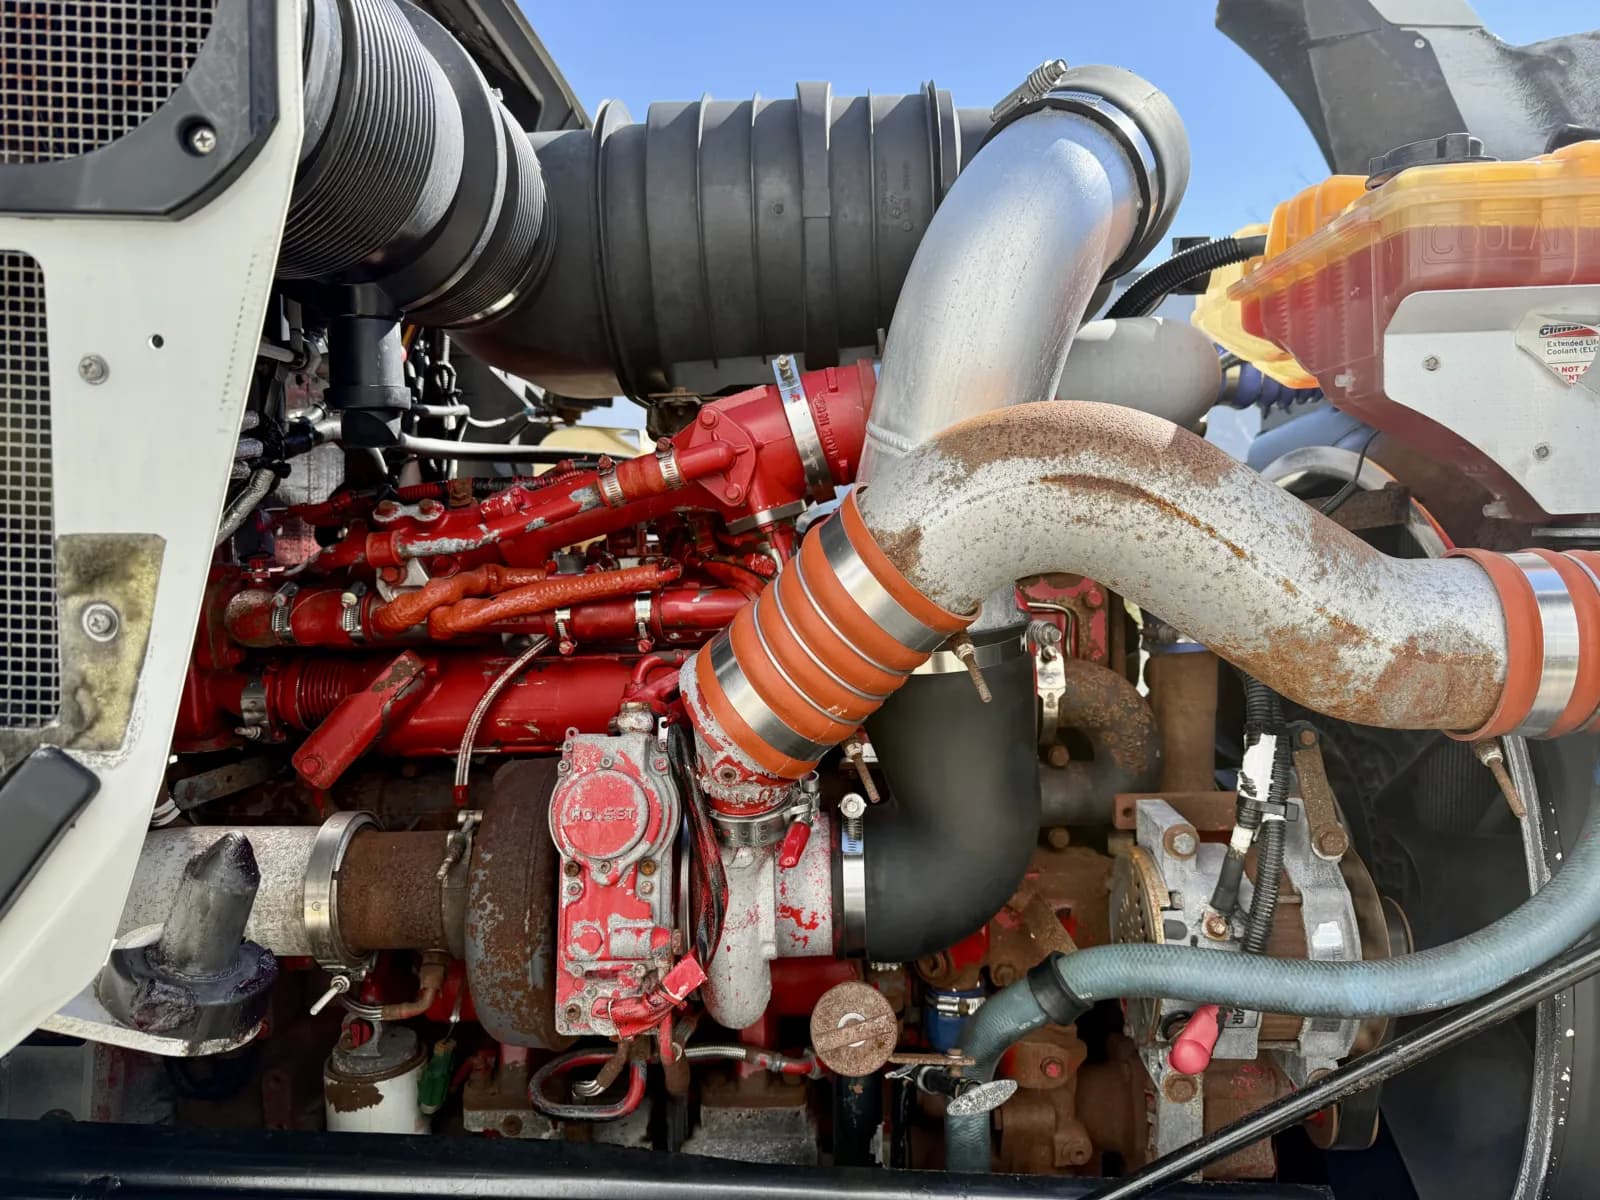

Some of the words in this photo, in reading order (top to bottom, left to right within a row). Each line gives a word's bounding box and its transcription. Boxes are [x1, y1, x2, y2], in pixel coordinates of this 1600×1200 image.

[1431, 214, 1597, 255] COOLAN
[1546, 339, 1584, 348] Extended
[1546, 347, 1578, 356] Coolant
[1561, 365, 1580, 373] NOT
